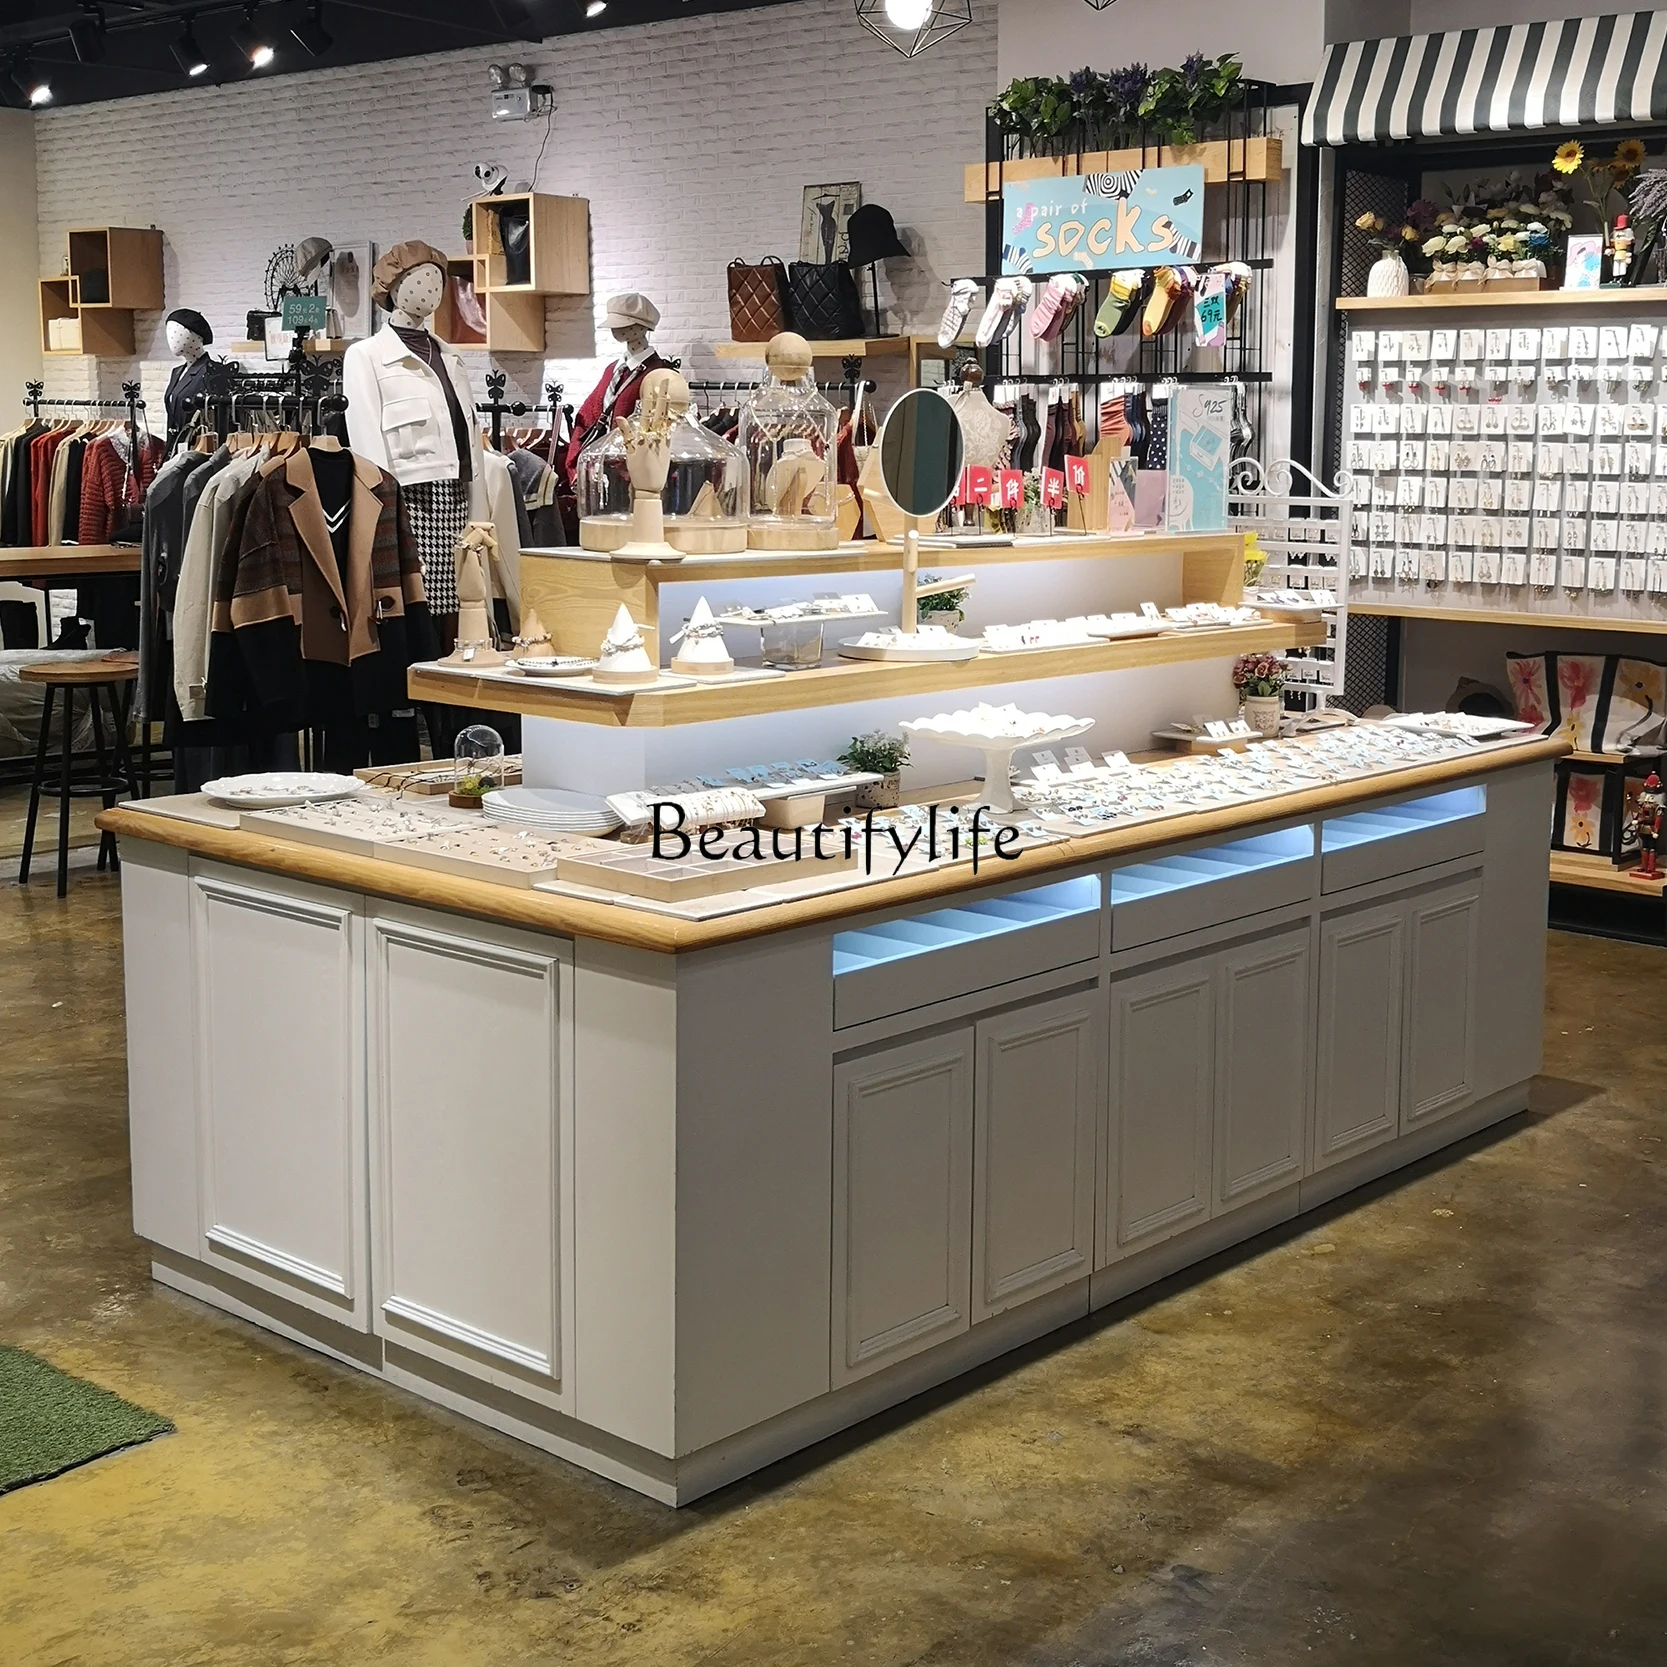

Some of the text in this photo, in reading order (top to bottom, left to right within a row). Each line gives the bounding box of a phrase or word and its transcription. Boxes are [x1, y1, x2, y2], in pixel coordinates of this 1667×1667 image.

[1016, 198, 1088, 222] a pair of
[1203, 296, 1220, 308] 三双
[1201, 309, 1222, 323] 69元
[1192, 394, 1227, 418] S925
